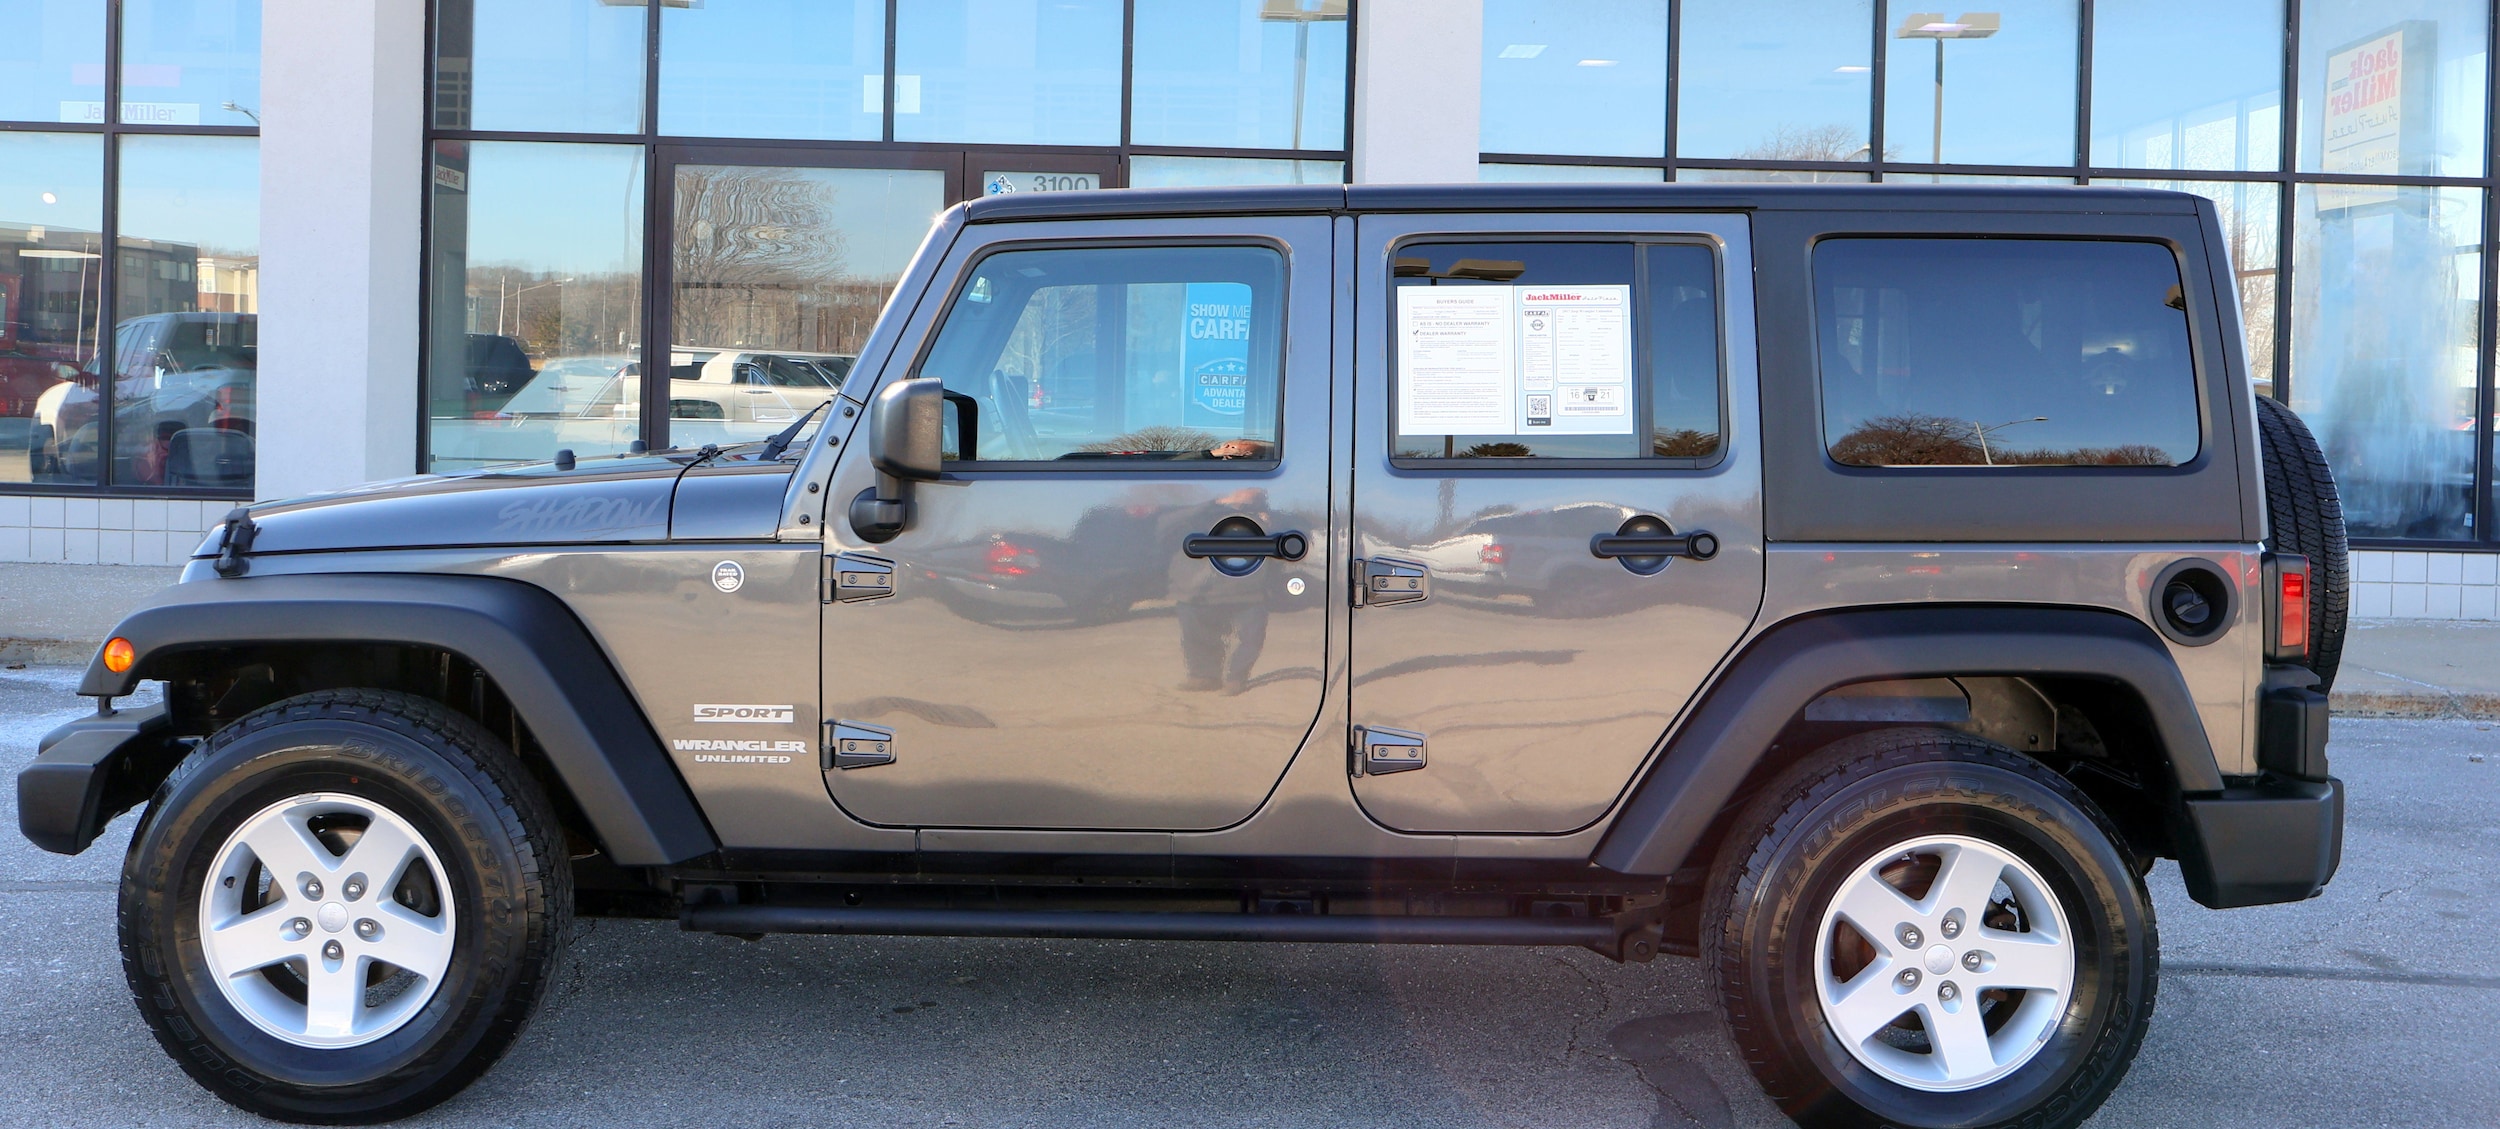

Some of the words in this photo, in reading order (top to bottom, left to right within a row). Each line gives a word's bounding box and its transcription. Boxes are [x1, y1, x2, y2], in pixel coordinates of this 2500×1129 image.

[992, 183, 999, 193] 3
[1033, 175, 1090, 192] 3100
[1190, 303, 1229, 317] SHOW
[1570, 391, 1580, 399] 16
[1600, 391, 1610, 399] 21
[493, 495, 664, 537] SHADOW
[697, 705, 790, 719] SPORT
[672, 739, 808, 753] WRANGLER
[695, 754, 792, 764] UNLIMITED
[1778, 776, 1984, 899] DUELER
[338, 736, 513, 986] BRIDGESTONE
